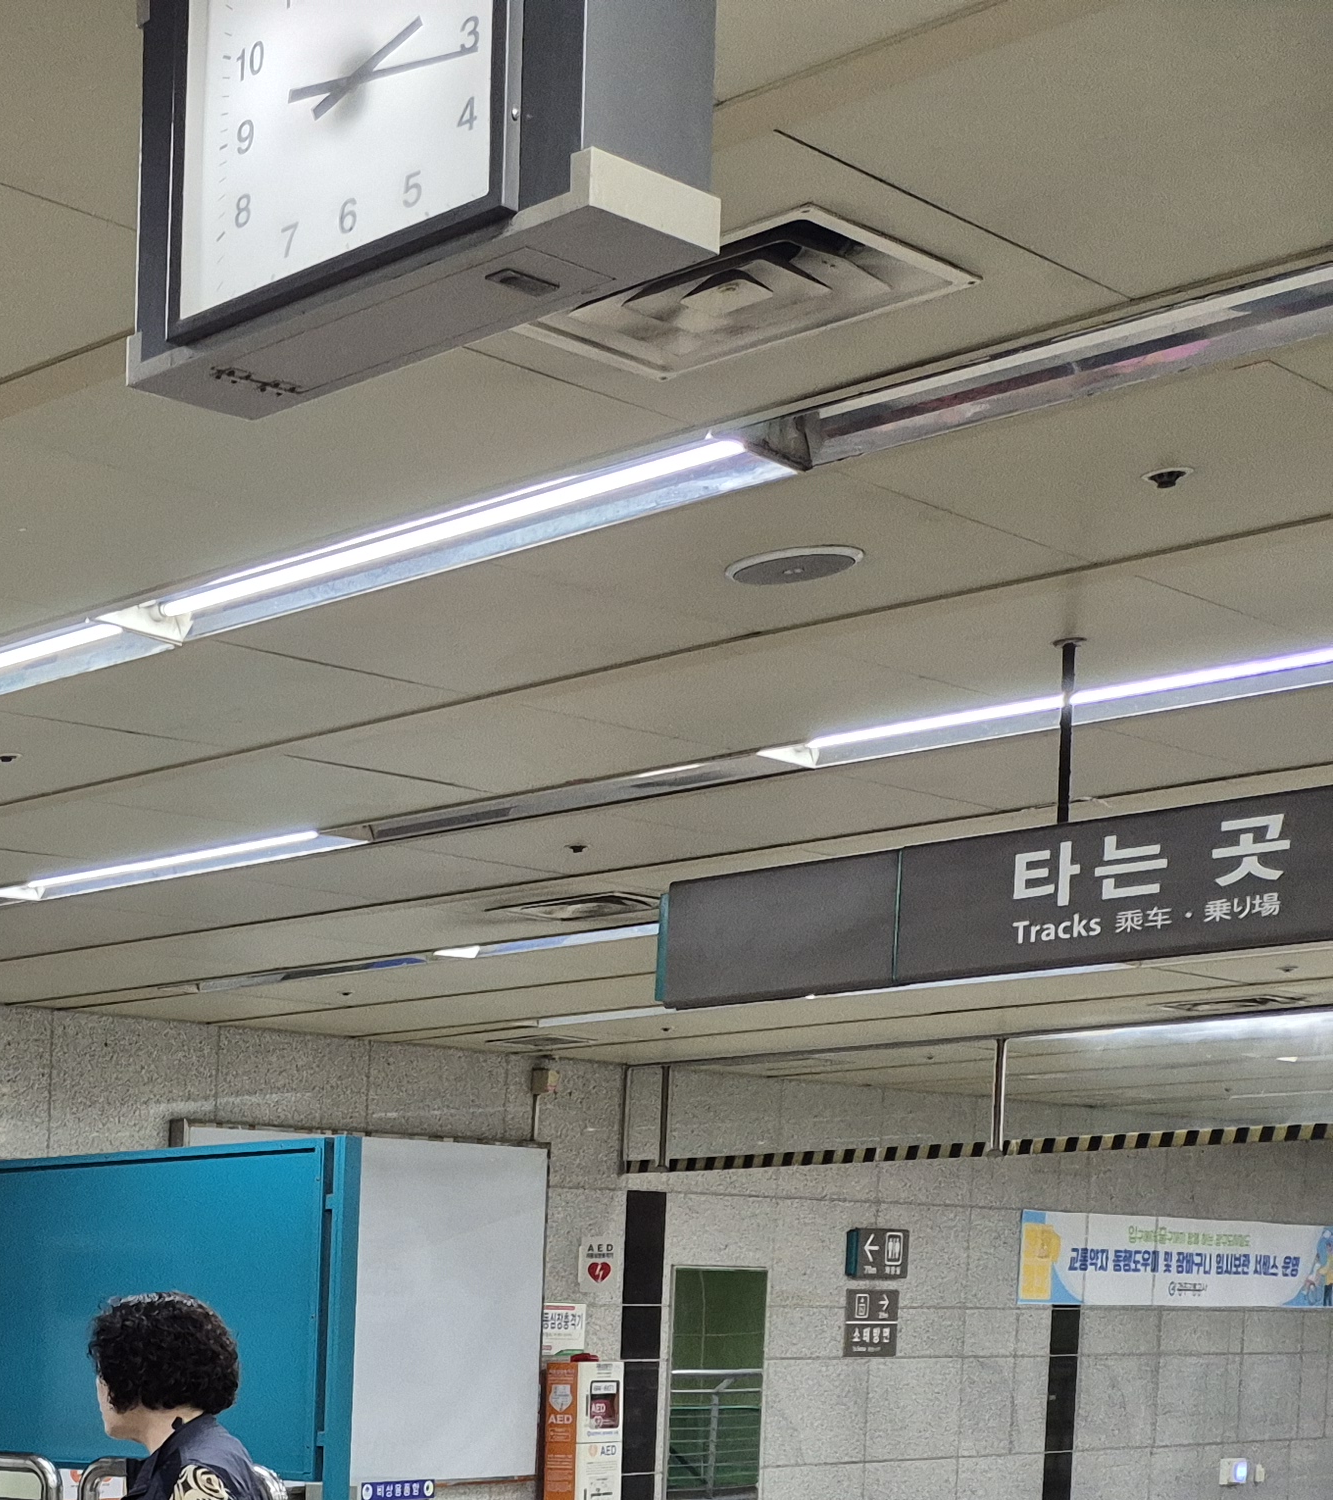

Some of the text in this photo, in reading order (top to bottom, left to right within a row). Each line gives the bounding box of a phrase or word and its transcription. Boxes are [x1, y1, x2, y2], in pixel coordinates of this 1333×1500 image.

[460, 15, 480, 51] 3
[236, 40, 264, 83] 10
[458, 96, 477, 131] 4
[236, 120, 255, 154] 9
[403, 171, 422, 208] 5
[234, 193, 252, 228] 8
[339, 198, 357, 235] 6
[281, 223, 300, 259] 7
[1013, 814, 1291, 907] 타는 곳
[1013, 912, 1102, 944] Tracks
[588, 1244, 614, 1252] AED
[1068, 1248, 1109, 1272] 교통약자
[548, 1415, 573, 1424] AED
[600, 1445, 617, 1456] AED
